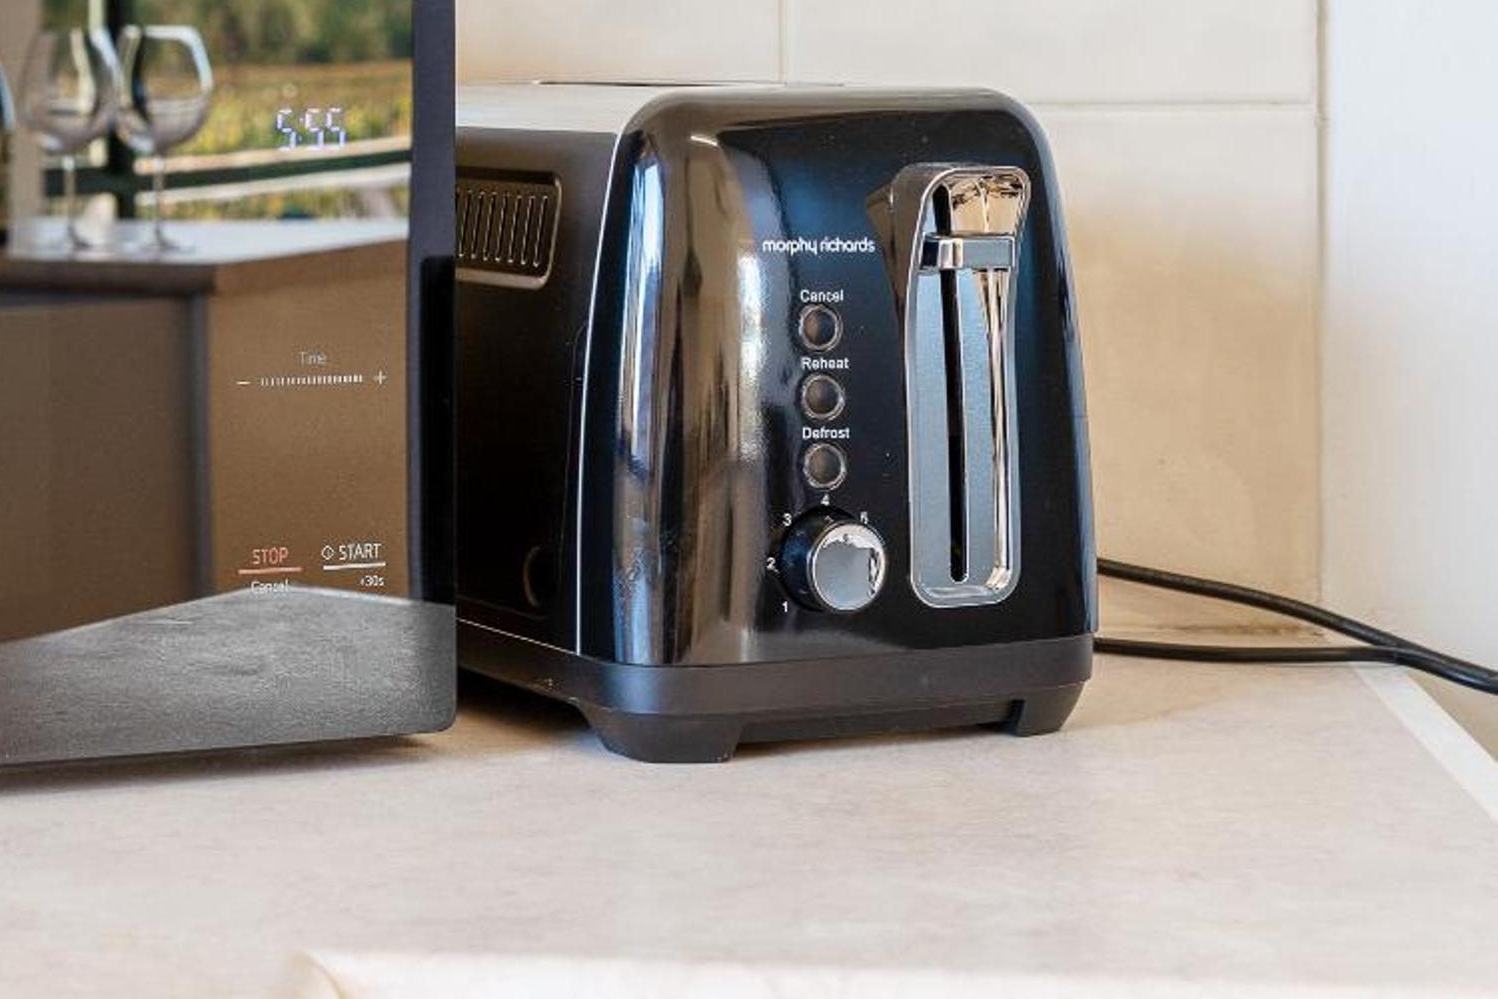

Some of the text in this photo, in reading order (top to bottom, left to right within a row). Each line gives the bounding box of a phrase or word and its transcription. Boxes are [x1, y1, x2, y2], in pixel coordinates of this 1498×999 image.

[762, 236, 876, 257] morphy richards
[800, 289, 844, 303] Cancel
[801, 356, 850, 370] Reheat
[802, 426, 850, 440] Defrost
[820, 493, 830, 506] 4
[782, 512, 792, 527] 3
[252, 547, 289, 565] STOP
[338, 543, 382, 561] START
[766, 557, 777, 571] 2
[782, 601, 789, 613] 1
